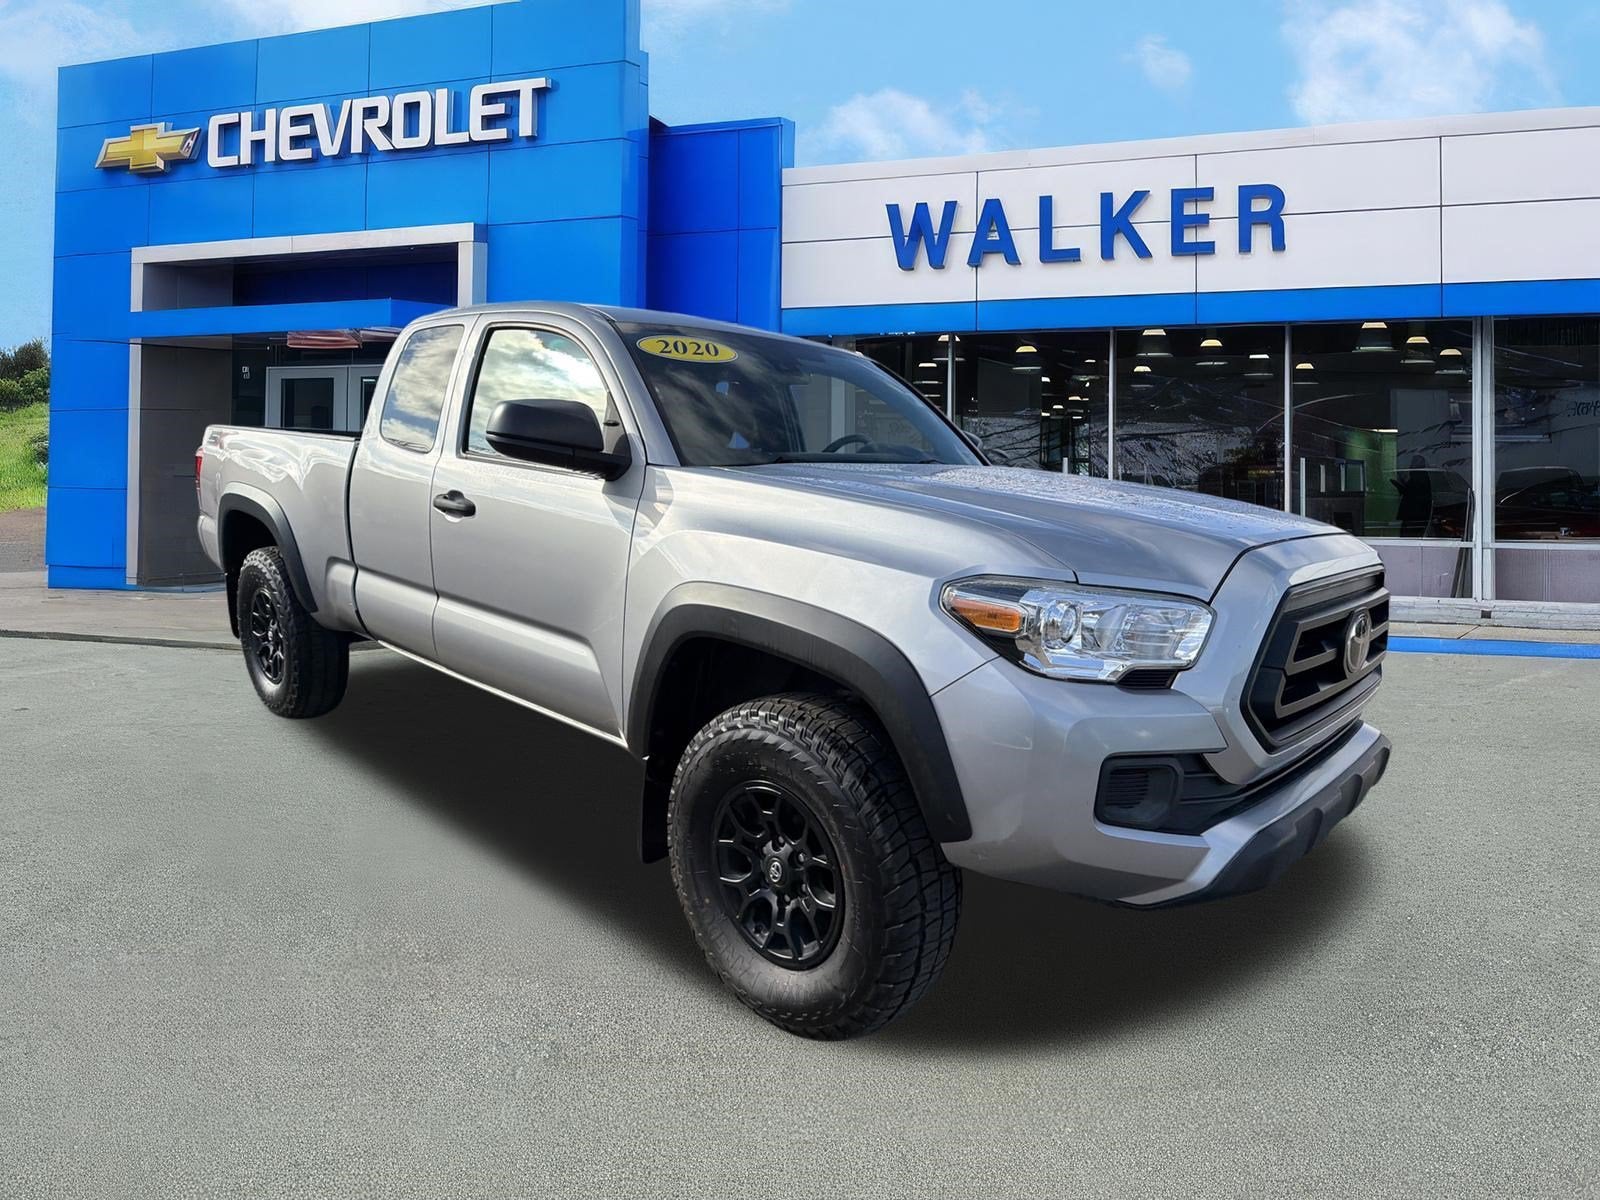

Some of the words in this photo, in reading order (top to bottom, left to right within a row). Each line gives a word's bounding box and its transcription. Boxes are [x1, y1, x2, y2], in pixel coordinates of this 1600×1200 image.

[207, 77, 551, 168] CHEVROLET
[885, 183, 1287, 271] WALKER
[655, 339, 719, 357] 2020
